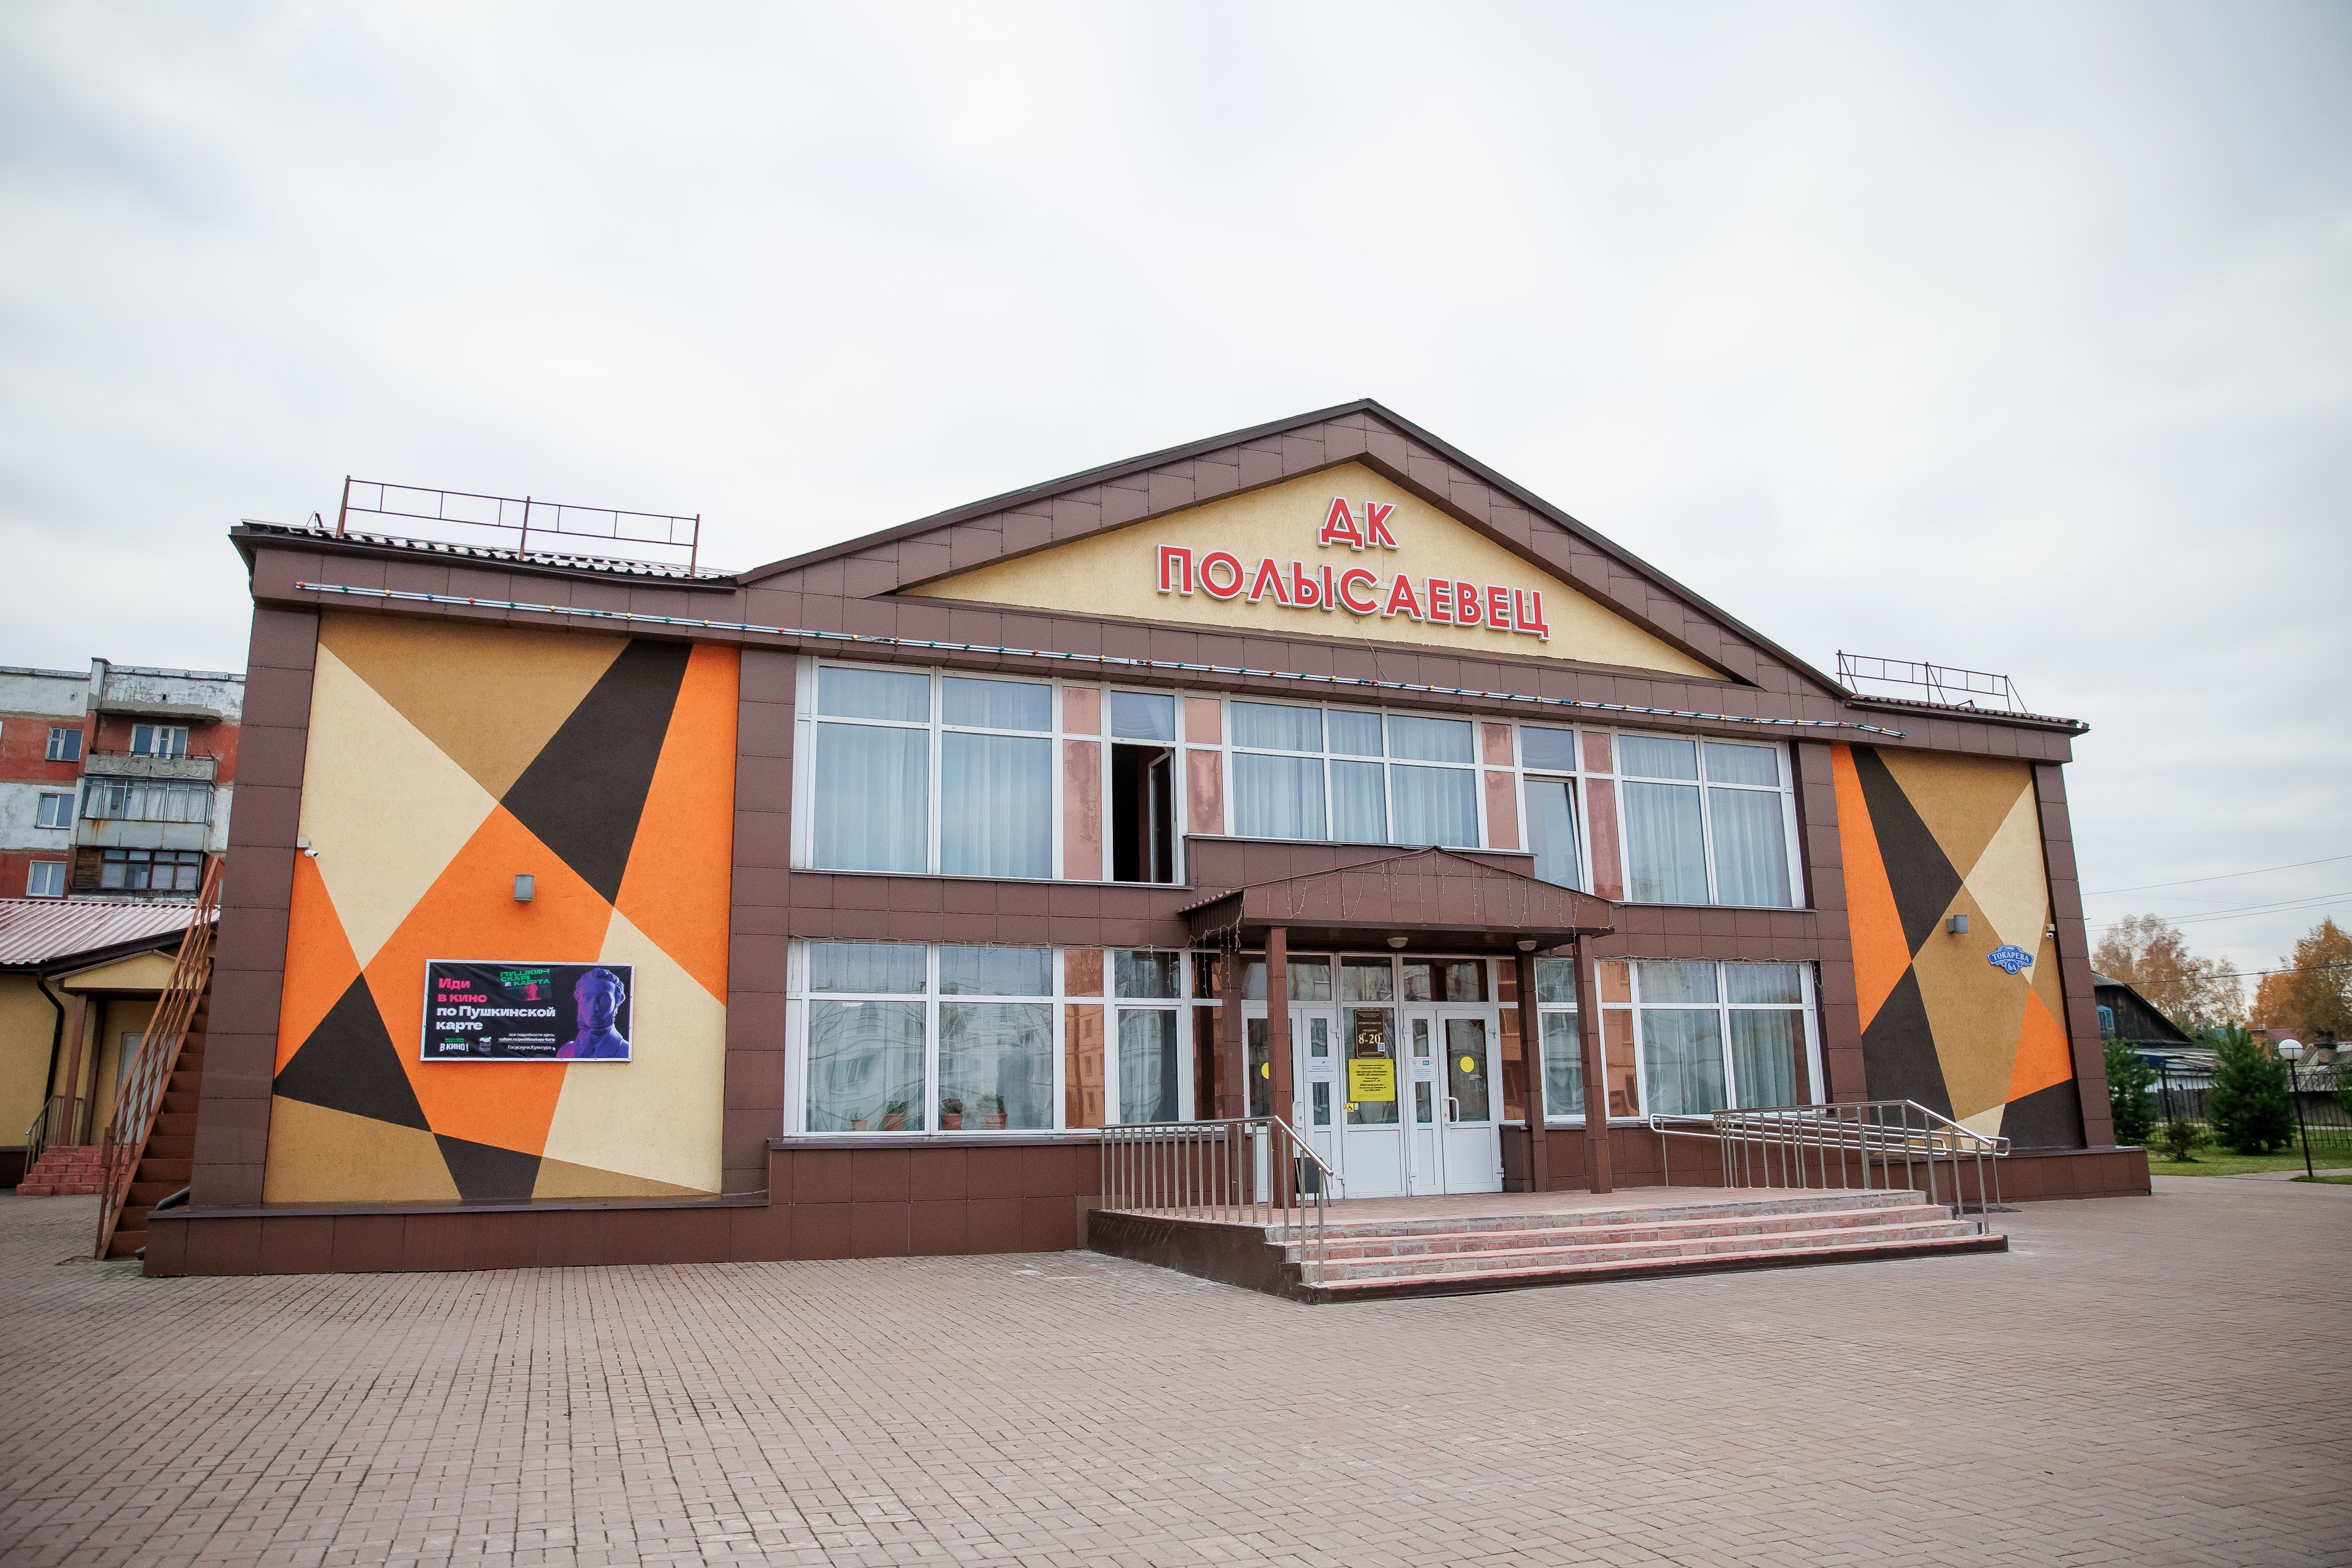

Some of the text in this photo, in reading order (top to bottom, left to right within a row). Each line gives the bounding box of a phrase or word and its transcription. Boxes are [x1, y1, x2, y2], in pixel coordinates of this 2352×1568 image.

[1317, 496, 1401, 551] ДК
[1156, 543, 1551, 642] ПОЛЫСАЕВЕЦ
[1992, 951, 2029, 963] ТОКАРЕВА
[500, 969, 550, 977] ПУШКИН
[438, 978, 470, 990] Иди
[437, 1006, 556, 1019] по Пушкинской
[436, 1021, 483, 1033] карте
